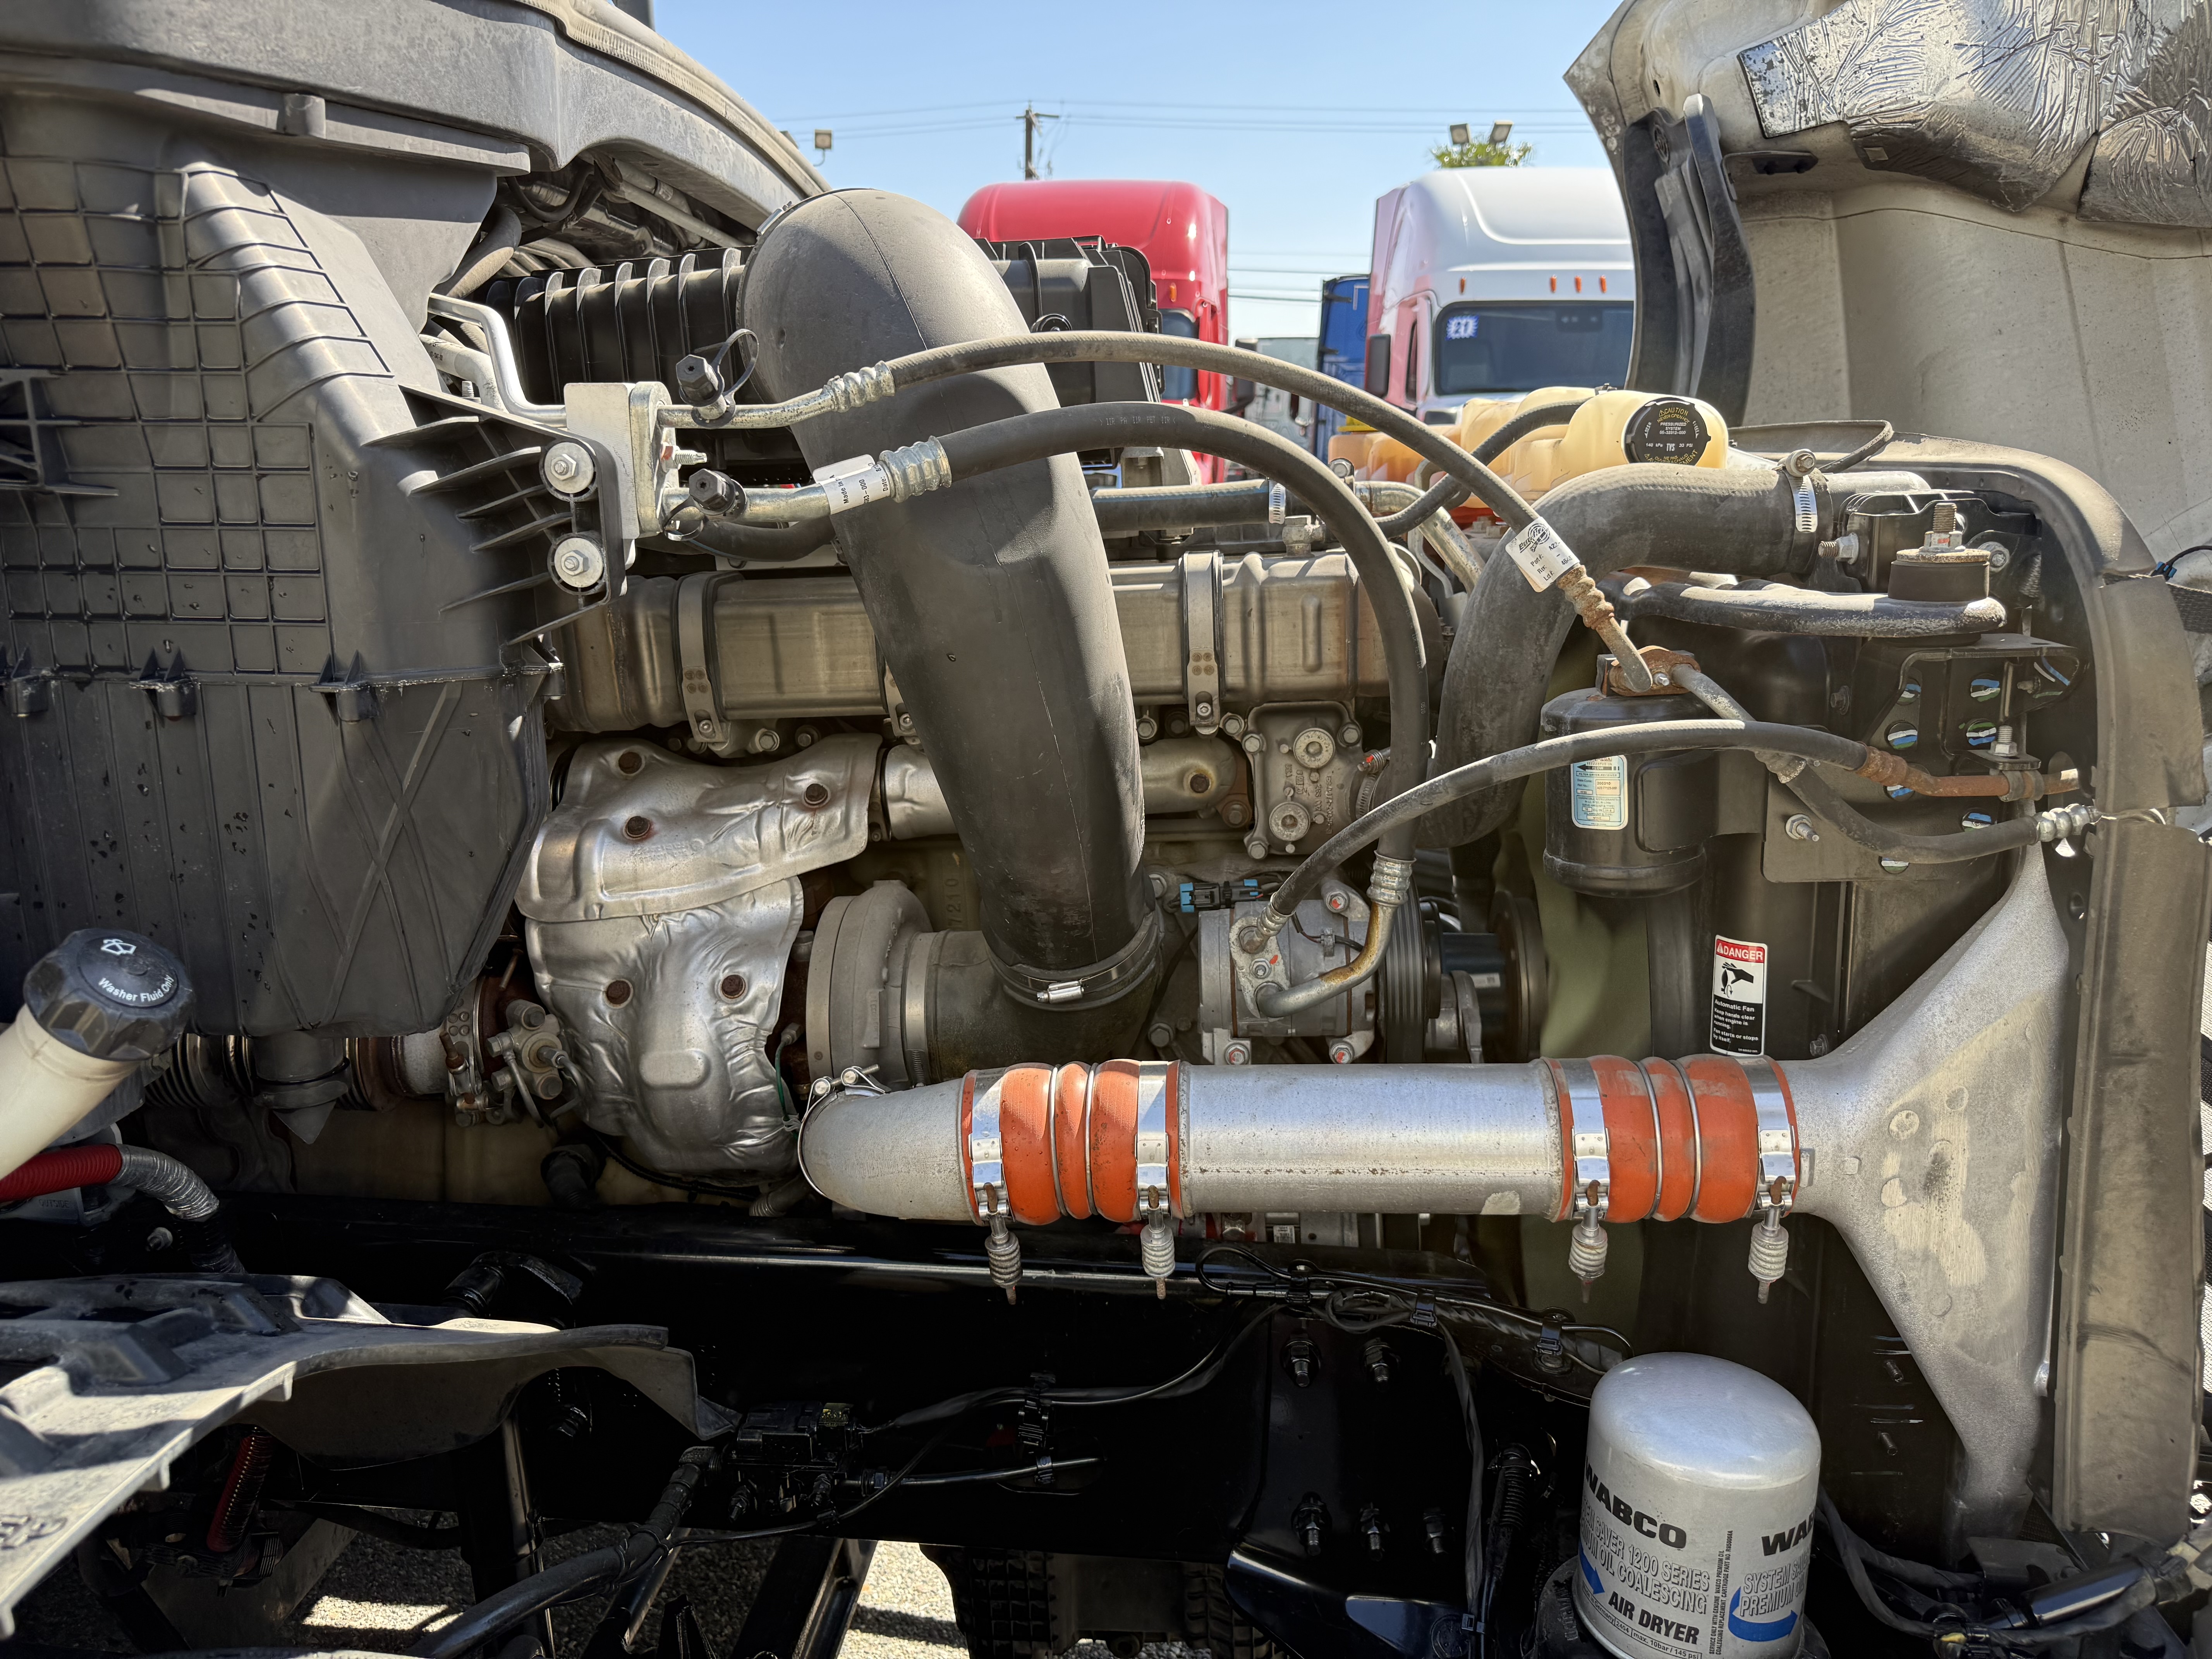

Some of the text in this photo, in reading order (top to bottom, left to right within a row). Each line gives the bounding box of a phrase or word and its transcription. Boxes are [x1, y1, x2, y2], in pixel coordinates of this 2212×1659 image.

[1664, 407, 1688, 416] CAUTION
[1666, 443, 1675, 452] TVS
[841, 488, 850, 504] Made
[1724, 946, 1763, 960] DANGER
[98, 974, 174, 1002] Washer Fluid Only
[1715, 999, 1741, 1010] Automatic
[1714, 1020, 1731, 1029] running.
[1586, 1456, 1687, 1549] WABCO
[1595, 1516, 1625, 1560] SAVER
[1628, 1544, 1659, 1577] 1200
[1661, 1560, 1710, 1592] SERIES
[1599, 1544, 1615, 1577] OIL
[1617, 1561, 1707, 1614] COALESCING
[1743, 1563, 1791, 1594] SYSTEM
[1740, 1582, 1795, 1617] PREMIUM
[1594, 1599, 1615, 1625] Germany
[1616, 1620, 1630, 1634] 2404
[1633, 1632, 1648, 1644] max.
[1650, 1639, 1670, 1653] 10bar
[1674, 1648, 1686, 1658] 145
[1608, 1590, 1635, 1621] AIR
[1638, 1609, 1700, 1645] DRYER
